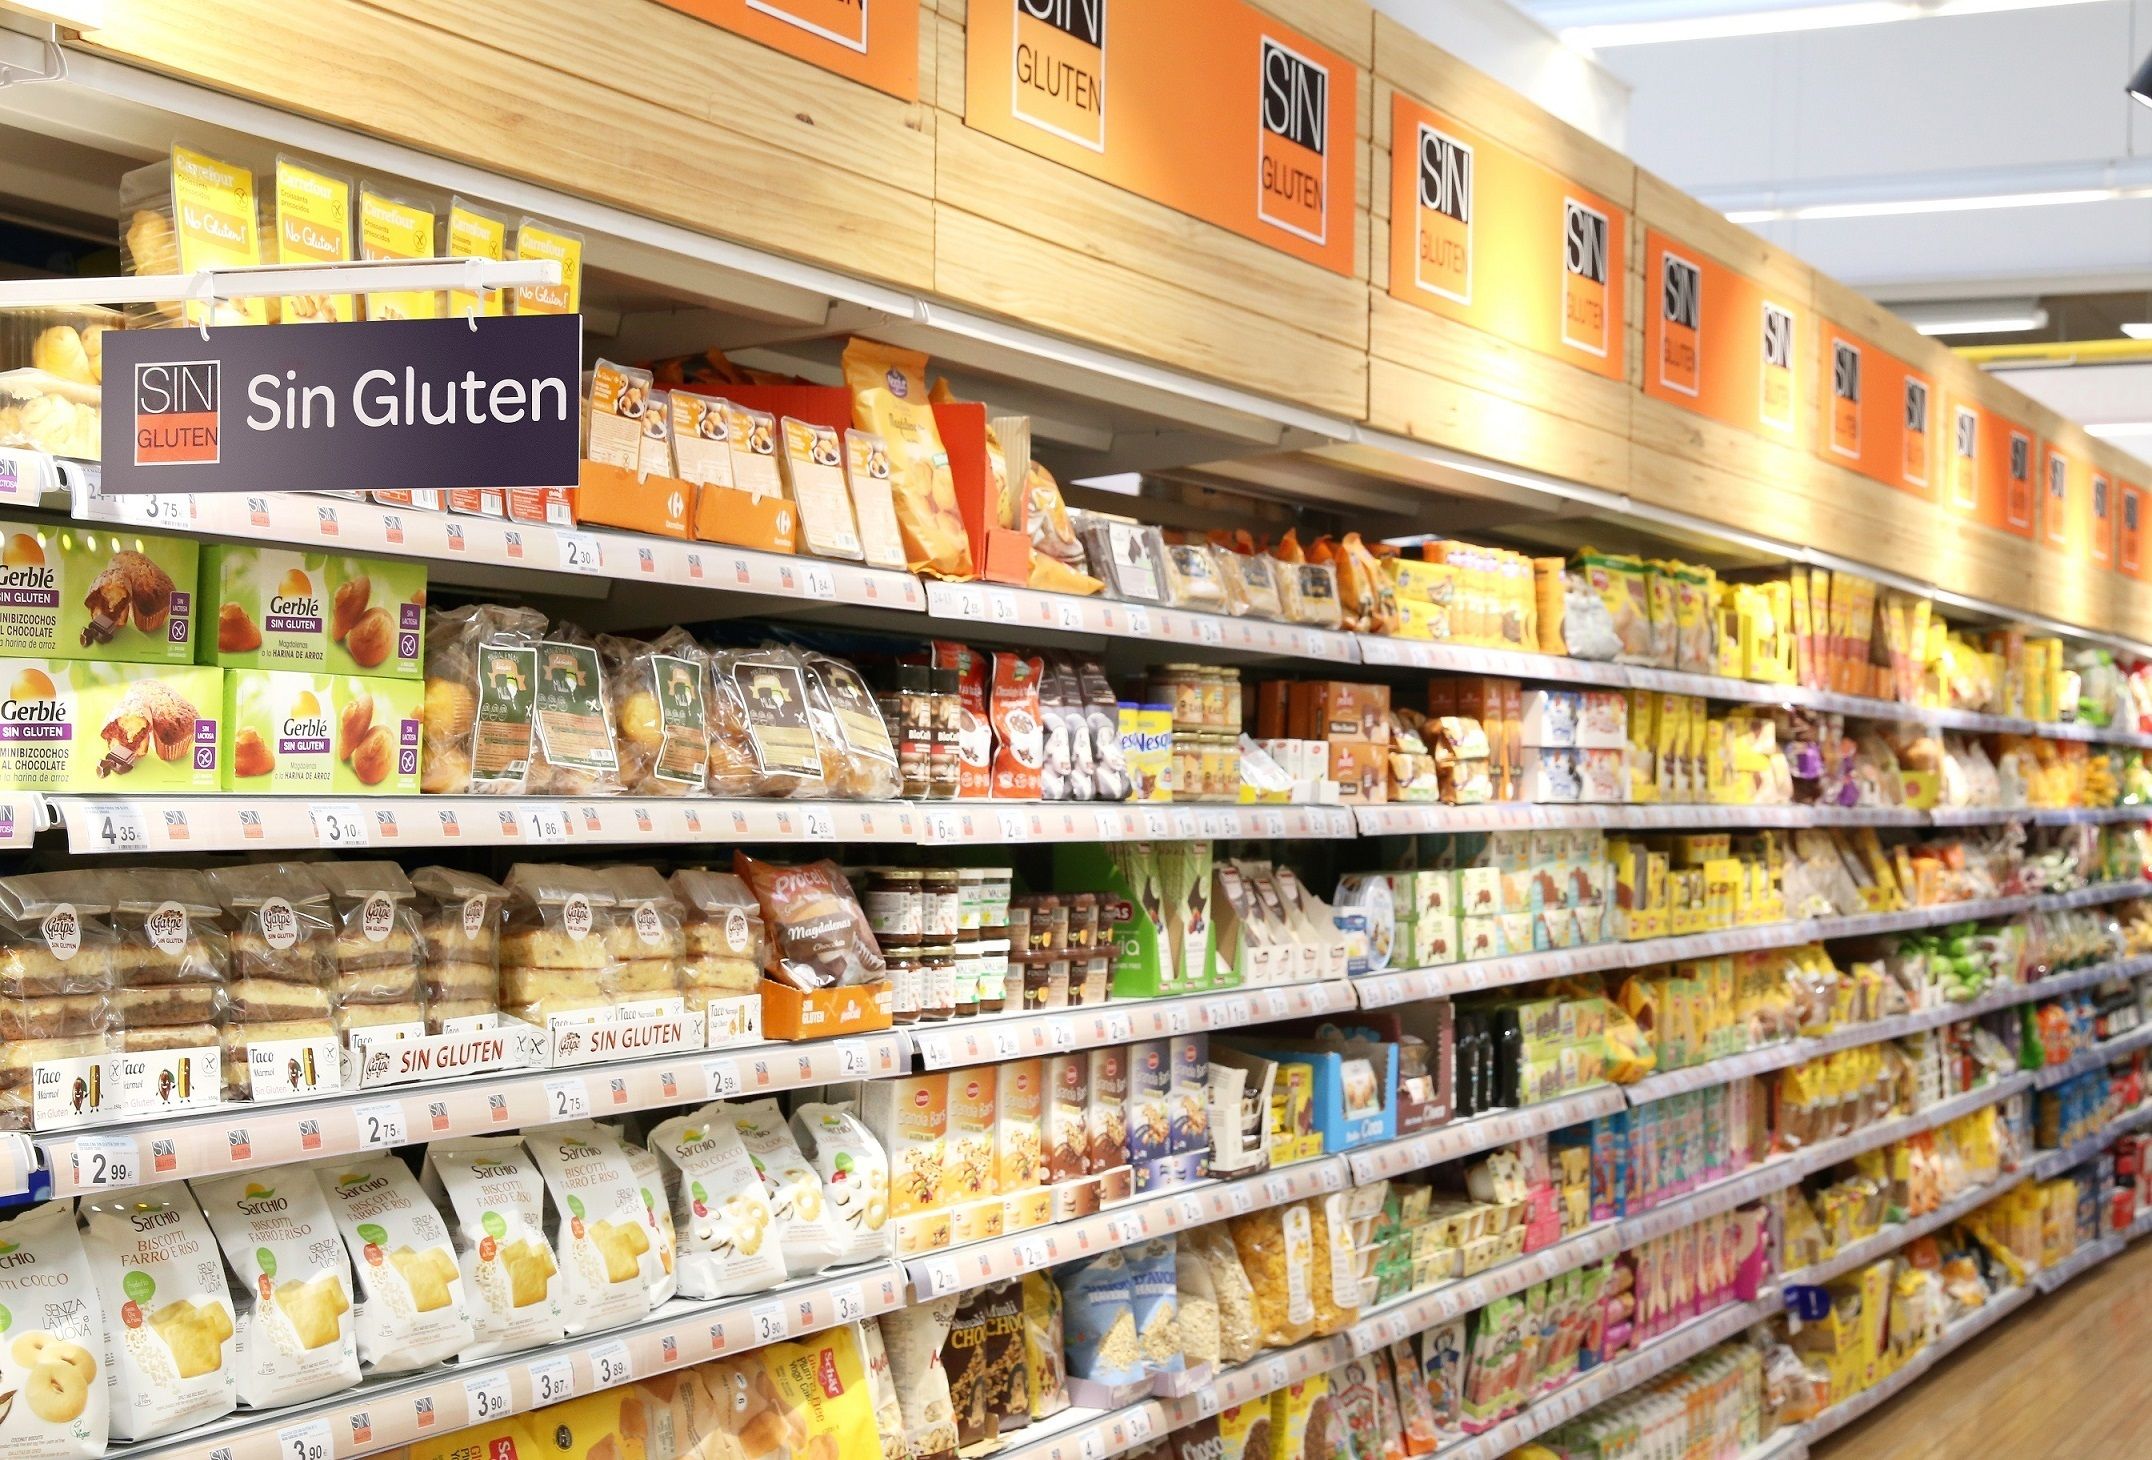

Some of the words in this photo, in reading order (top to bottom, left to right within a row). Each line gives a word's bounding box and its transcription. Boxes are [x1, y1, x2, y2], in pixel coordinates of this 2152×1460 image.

[1016, 43, 1101, 115] GLUTEN
[1265, 47, 1323, 151] SIN
[1262, 155, 1323, 215] GLUTEN
[1421, 131, 1468, 222] SIN
[184, 207, 202, 230] No
[364, 202, 416, 230] Carrefour
[285, 221, 300, 242] No
[521, 234, 565, 258] Carrefour
[1421, 229, 1466, 274] GLUTEN
[1567, 206, 1605, 284] SIN
[519, 286, 534, 300] No
[1665, 257, 1696, 329] SIN
[1765, 307, 1791, 368] SIN
[141, 364, 215, 414] SIN
[246, 369, 335, 431] Sin
[353, 366, 567, 428] Gluten
[137, 427, 218, 449] GLUTEN
[146, 494, 159, 518] 3
[163, 502, 178, 518] 75
[567, 541, 578, 565] 2
[580, 551, 591, 564] 30
[0, 564, 55, 589] Gerblé
[809, 573, 817, 593] 1
[14, 593, 51, 604] GLUTEN
[270, 595, 319, 617] Gerblé
[964, 596, 970, 615] 2
[6, 627, 53, 638] CHOCOLATE
[270, 619, 284, 629] SIN
[285, 619, 316, 630] GLUTEN
[272, 649, 296, 659] HARINA
[295, 650, 304, 659] DE
[305, 651, 324, 660] ARROZ
[0, 699, 67, 722] Gerblé
[2, 726, 20, 738] SIN
[23, 725, 63, 738] GLUTEN
[283, 718, 328, 738] Gerblé
[0, 747, 70, 759] MINIBIZCOCHOS
[283, 741, 297, 751] SIN
[297, 740, 325, 751] GLUTEN
[1, 760, 12, 770] AL
[15, 759, 66, 772] CHOCOLATE
[163, 810, 188, 826] SIN
[238, 810, 262, 825] SIN
[532, 814, 542, 838] 1
[808, 814, 818, 835] 2
[101, 816, 117, 845] 4
[326, 815, 341, 841] 3
[343, 824, 357, 838] 10
[277, 932, 295, 940] GLUTEN
[373, 925, 389, 933] GLUTEN
[788, 918, 852, 941] Magdalenas
[51, 941, 60, 950] SIN
[60, 941, 77, 950] GLUTEN
[157, 937, 166, 945] SIN
[166, 937, 184, 945] GLUTEN
[619, 1007, 637, 1021] Taco
[710, 1004, 724, 1017] Taco
[590, 1030, 617, 1053] SIN
[622, 1022, 682, 1049] GLUTEN
[250, 1049, 274, 1064] Taco
[400, 1045, 430, 1074] SIN
[436, 1038, 504, 1068] GLUTEN
[847, 1050, 854, 1070] 2
[35, 1068, 61, 1086] Taco
[713, 1071, 722, 1093] 2
[724, 1077, 735, 1090] 59
[254, 1086, 265, 1095] Sin
[265, 1084, 287, 1095] Gluten
[556, 1091, 568, 1115] 2
[569, 1098, 581, 1111] 75
[36, 1110, 47, 1120] Sin
[48, 1108, 69, 1119] Gluten
[228, 1128, 251, 1147] SIN
[299, 1119, 319, 1136] SIN
[368, 1116, 381, 1143] 2
[152, 1138, 175, 1158] SIN
[92, 1153, 107, 1184] 2
[564, 1163, 606, 1177] BISCOTTI
[590, 1175, 598, 1185] E
[599, 1170, 620, 1182] RISO
[481, 1180, 523, 1195] BISCOTTI
[348, 1190, 398, 1213] BISCOTTI
[383, 1202, 392, 1212] E
[392, 1199, 412, 1210] RISO
[476, 1194, 508, 1208] FARRO
[248, 1230, 279, 1244] FARRO
[279, 1232, 285, 1240] E
[284, 1224, 312, 1241] RISO
[250, 1217, 293, 1232] BISCOTTI
[137, 1230, 187, 1252] BISCOTTI
[309, 1238, 339, 1254] SENZA
[121, 1251, 170, 1267] FARRO
[172, 1247, 180, 1259] E
[180, 1240, 200, 1256] RISO
[308, 1250, 335, 1264] LATTE
[1026, 1247, 1035, 1265] 2
[197, 1261, 217, 1275] SENZA
[19, 1272, 70, 1288] COCCO
[936, 1270, 945, 1289] 2
[44, 1299, 87, 1317] SENZA
[840, 1297, 849, 1319] 3
[42, 1315, 82, 1331] LATTE
[761, 1317, 770, 1339] 3
[600, 1358, 612, 1382] 3
[613, 1362, 624, 1376] 89
[796, 1356, 814, 1380] Plum
[541, 1374, 552, 1400] 3
[415, 1397, 434, 1414] SIN
[477, 1392, 489, 1417] 3
[350, 1412, 371, 1430] SIN
[293, 1440, 306, 1460] 3
